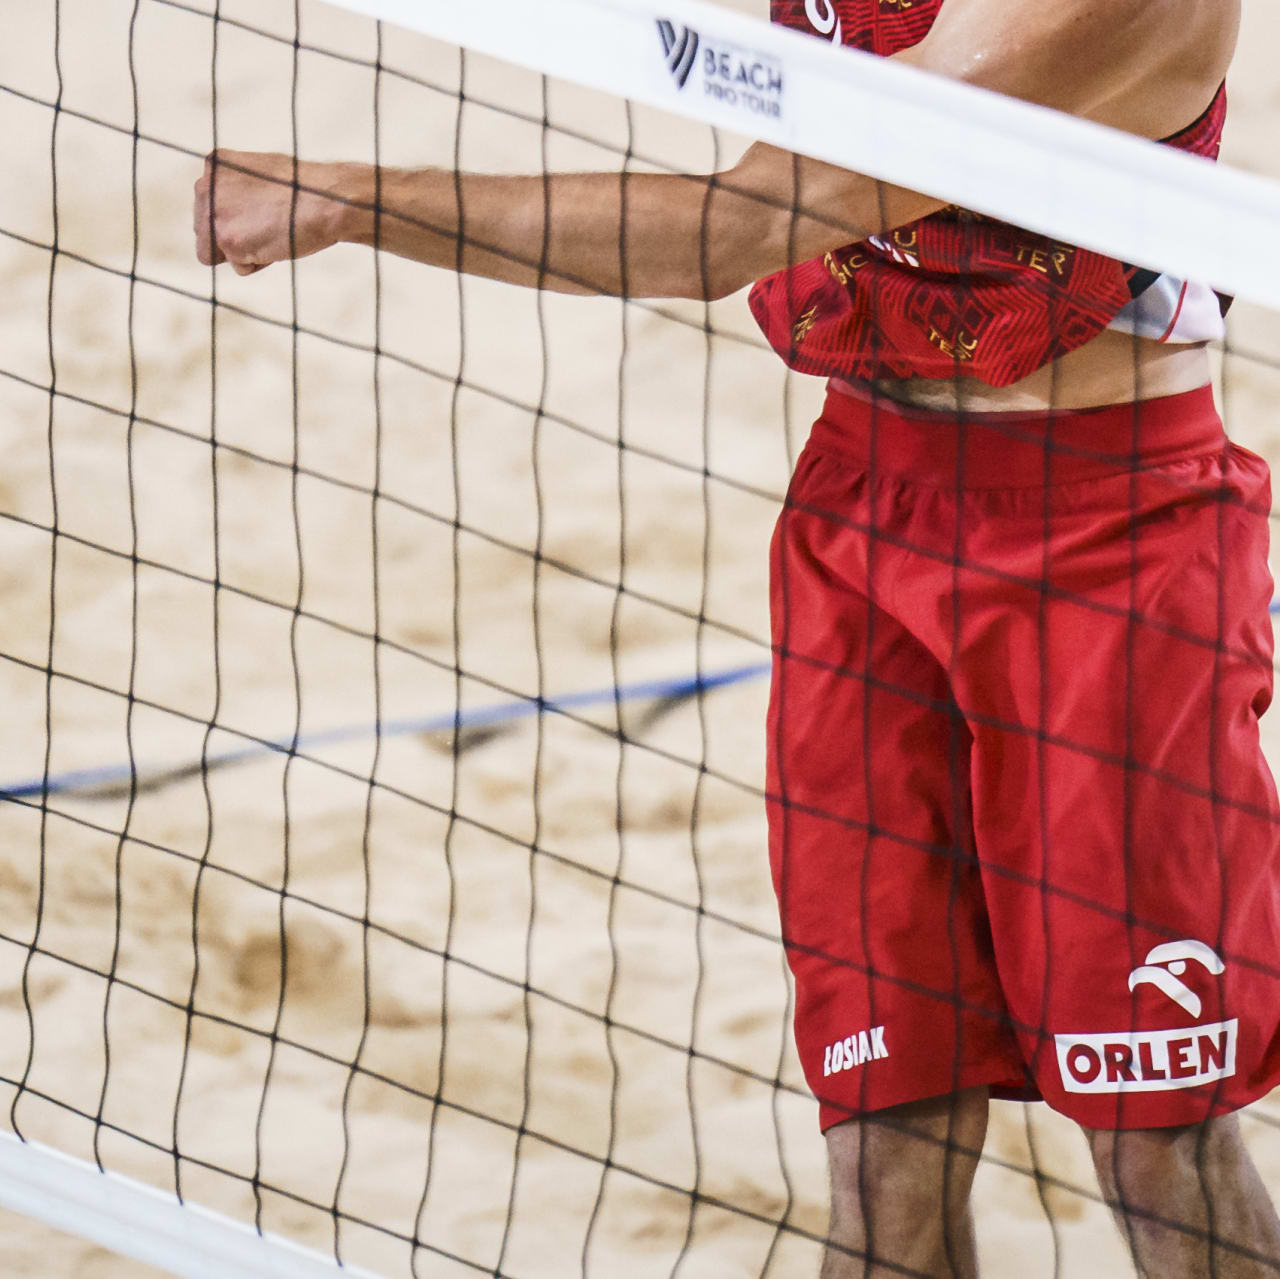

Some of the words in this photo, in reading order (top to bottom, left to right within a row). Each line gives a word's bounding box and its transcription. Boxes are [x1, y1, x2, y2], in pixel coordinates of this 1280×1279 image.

[704, 47, 782, 94] BEACH
[741, 90, 781, 118] TOUR
[1066, 1030, 1229, 1085] ORLEN
